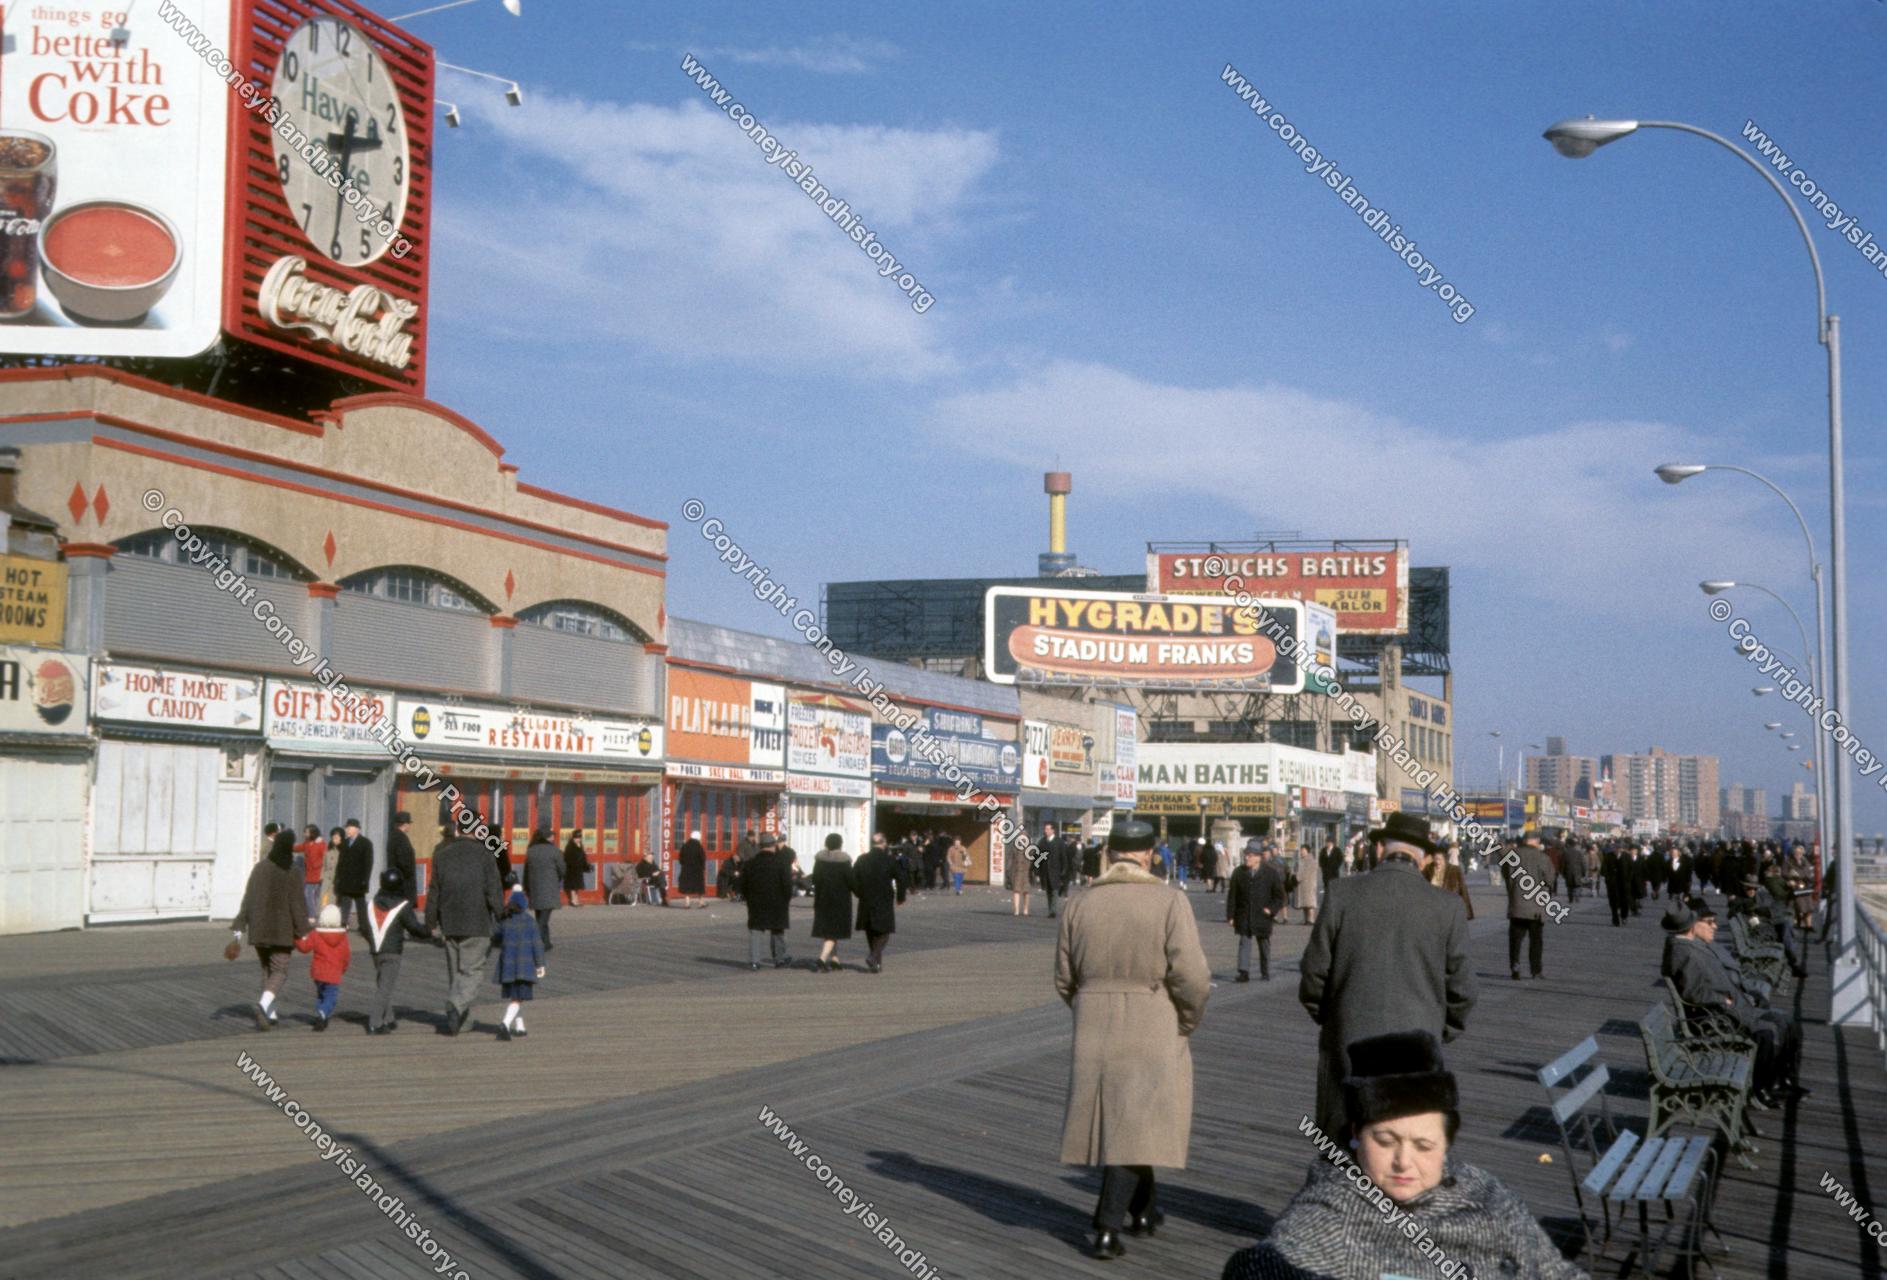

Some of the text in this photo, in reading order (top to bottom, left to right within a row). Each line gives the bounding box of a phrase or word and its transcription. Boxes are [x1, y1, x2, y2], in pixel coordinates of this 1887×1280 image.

[32, 6, 128, 29] things go
[31, 25, 122, 58] better
[335, 20, 350, 57] 12
[68, 48, 163, 85] with
[282, 48, 298, 82] 10
[28, 72, 171, 126] Coke
[386, 102, 396, 134] 2
[279, 153, 289, 186] 8
[393, 156, 403, 186] 3
[302, 203, 312, 235] 7
[331, 231, 342, 261] 6
[360, 229, 371, 259] 5
[6, 567, 42, 587] HOT
[1174, 556, 1387, 577] STUCHS BATHS
[0, 587, 48, 605] STEAM
[1336, 590, 1371, 601] SUN
[1029, 598, 1262, 635] HYGRADE'S
[1033, 635, 1254, 665] STADIUM FRANKS
[125, 672, 228, 701] HOME MADE
[147, 697, 207, 721] CANDY
[274, 688, 325, 721] GIFT
[671, 695, 749, 739] PLAYLAND
[272, 720, 297, 737] HATS
[303, 724, 338, 739] JEWELRY
[462, 722, 481, 733] FOOD
[488, 728, 594, 753] RESTAURANT
[1025, 724, 1049, 756] PIZZA
[1117, 766, 1136, 781] CLAM
[1138, 764, 1187, 784] MAN
[1195, 764, 1269, 785] BATHS
[1279, 759, 1315, 785] BUSHMAN
[1319, 766, 1341, 790] BATHS
[1117, 783, 1134, 799] BAR
[663, 806, 671, 872] PHOTOS
